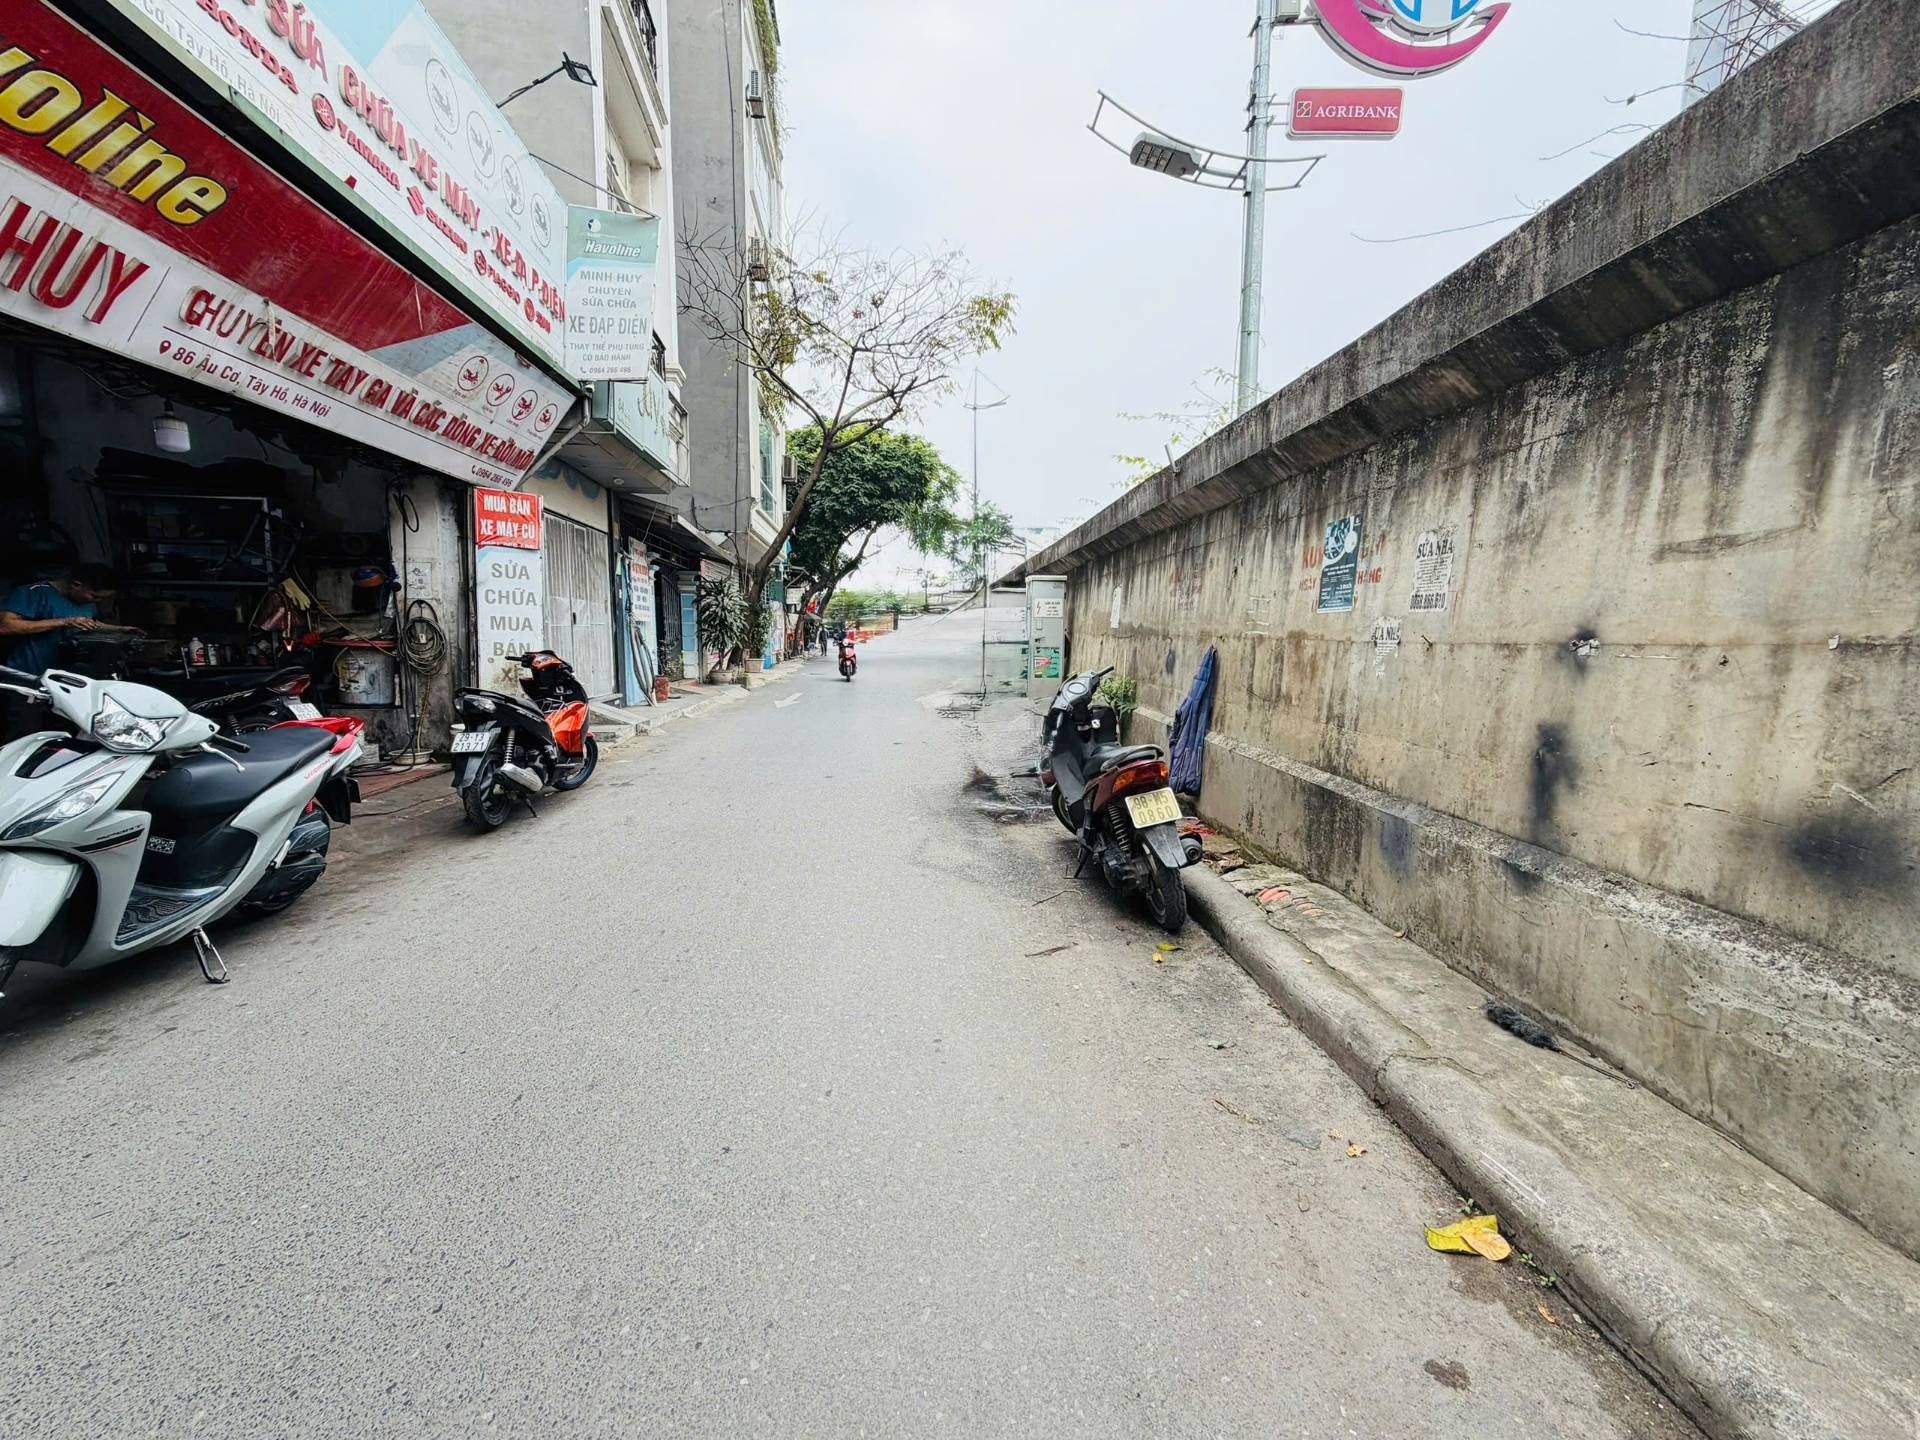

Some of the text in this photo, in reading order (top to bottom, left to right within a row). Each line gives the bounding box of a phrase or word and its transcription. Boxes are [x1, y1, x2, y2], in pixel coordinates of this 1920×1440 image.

[1315, 105, 1398, 119] AGRIBANK
[409, 138, 439, 191] XE
[440, 173, 480, 231] MÁY
[490, 226, 512, 267] XE
[584, 238, 641, 257] Havoline
[580, 270, 643, 283] MINH HUY
[569, 315, 585, 333] XE
[288, 341, 329, 378] XE
[322, 356, 370, 395] TAY
[172, 347, 196, 366] 86
[197, 353, 218, 375] Âu
[246, 374, 270, 396] Tây
[291, 394, 309, 409] Hà
[483, 494, 530, 515] MUA BÁN
[480, 518, 494, 536] XE
[496, 518, 519, 538] MÁY
[491, 559, 530, 580] SỬA
[484, 587, 537, 606] CHỮA
[490, 615, 533, 631] MUA
[493, 638, 531, 656] BÁN
